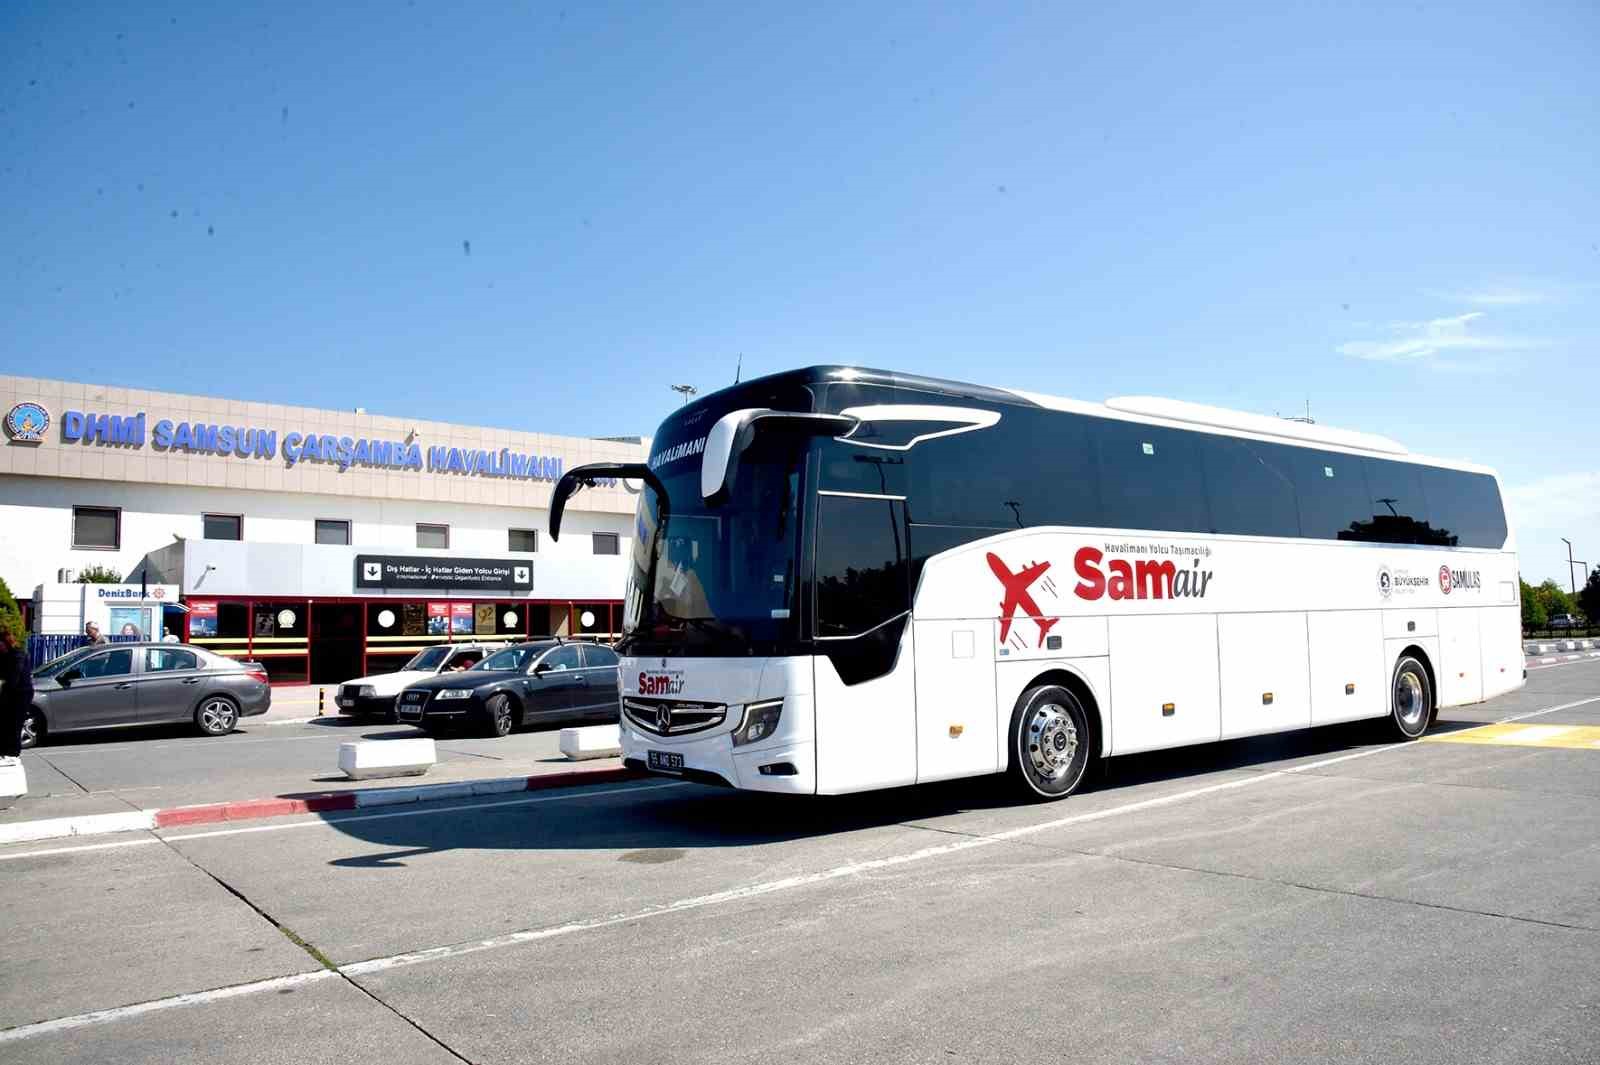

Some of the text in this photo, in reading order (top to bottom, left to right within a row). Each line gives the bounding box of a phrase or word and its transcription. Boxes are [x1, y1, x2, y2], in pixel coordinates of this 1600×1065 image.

[63, 411, 563, 482] DHMİ SAMSUN ÇARŞAMBA HAVALİMANI
[1104, 543, 1148, 554] Havalimanı
[1149, 544, 1169, 555] Yolcu
